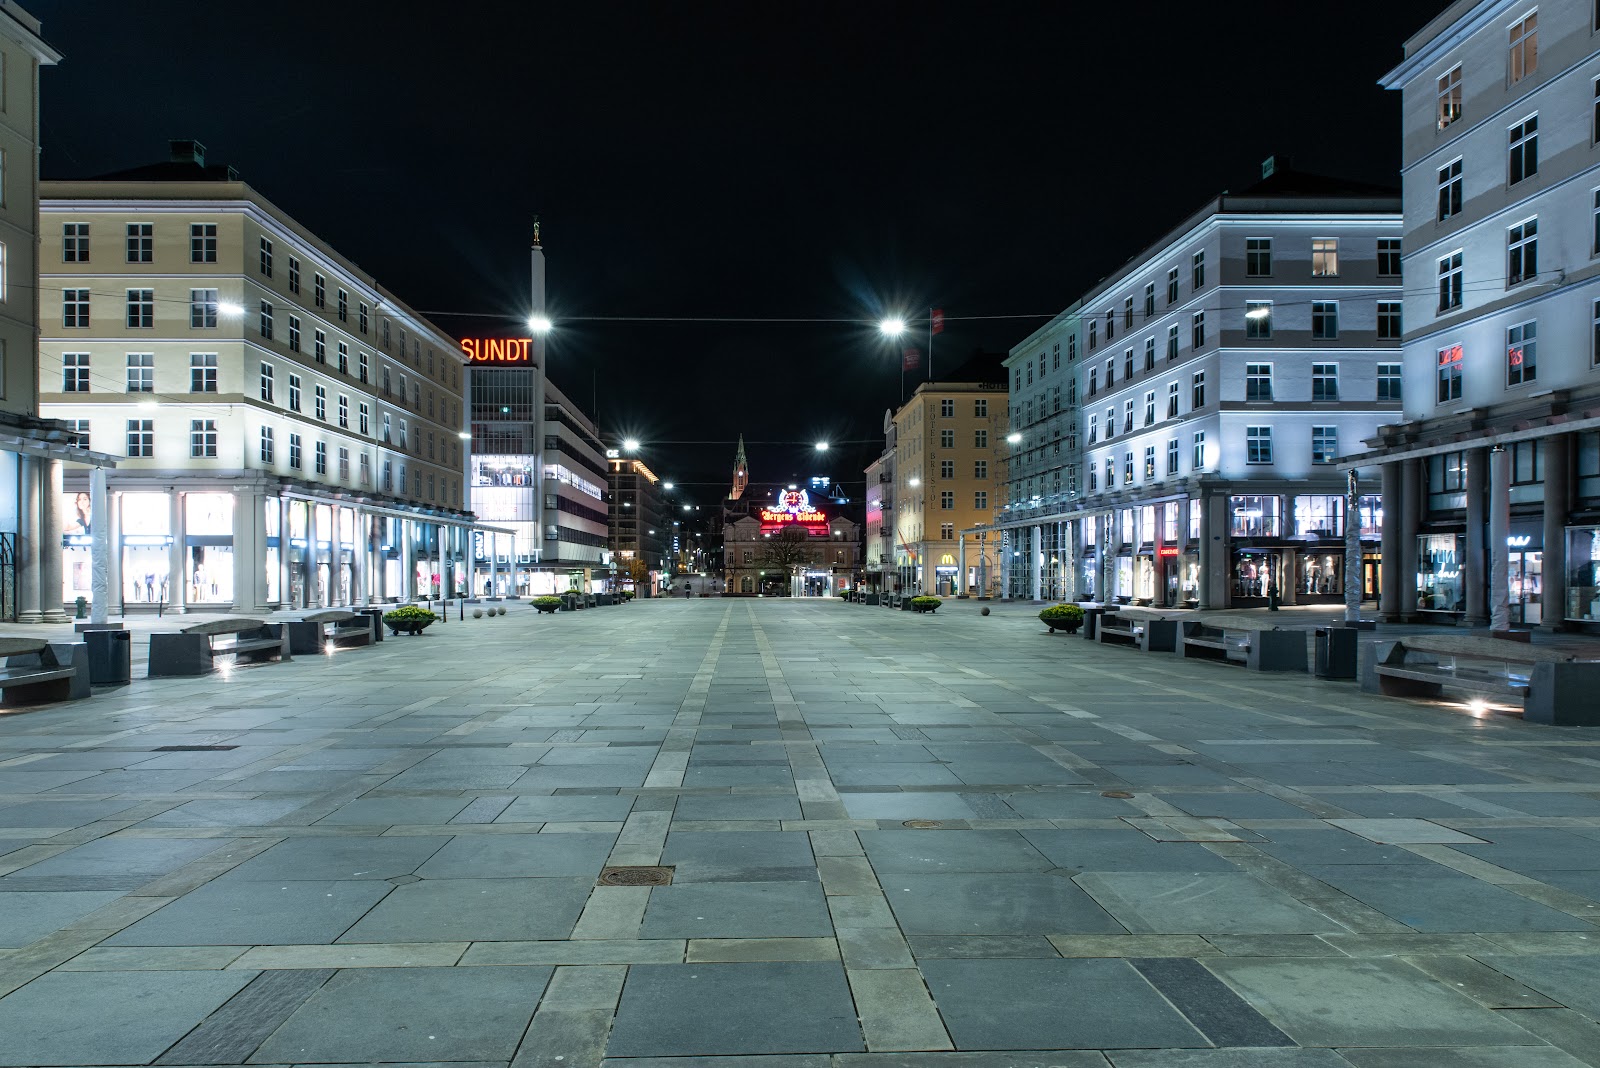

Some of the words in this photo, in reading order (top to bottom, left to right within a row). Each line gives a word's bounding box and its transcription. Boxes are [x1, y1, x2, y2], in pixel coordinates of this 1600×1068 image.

[460, 338, 533, 361] SUNDT
[982, 382, 1009, 390] HOTE
[475, 532, 484, 560] ONLY
